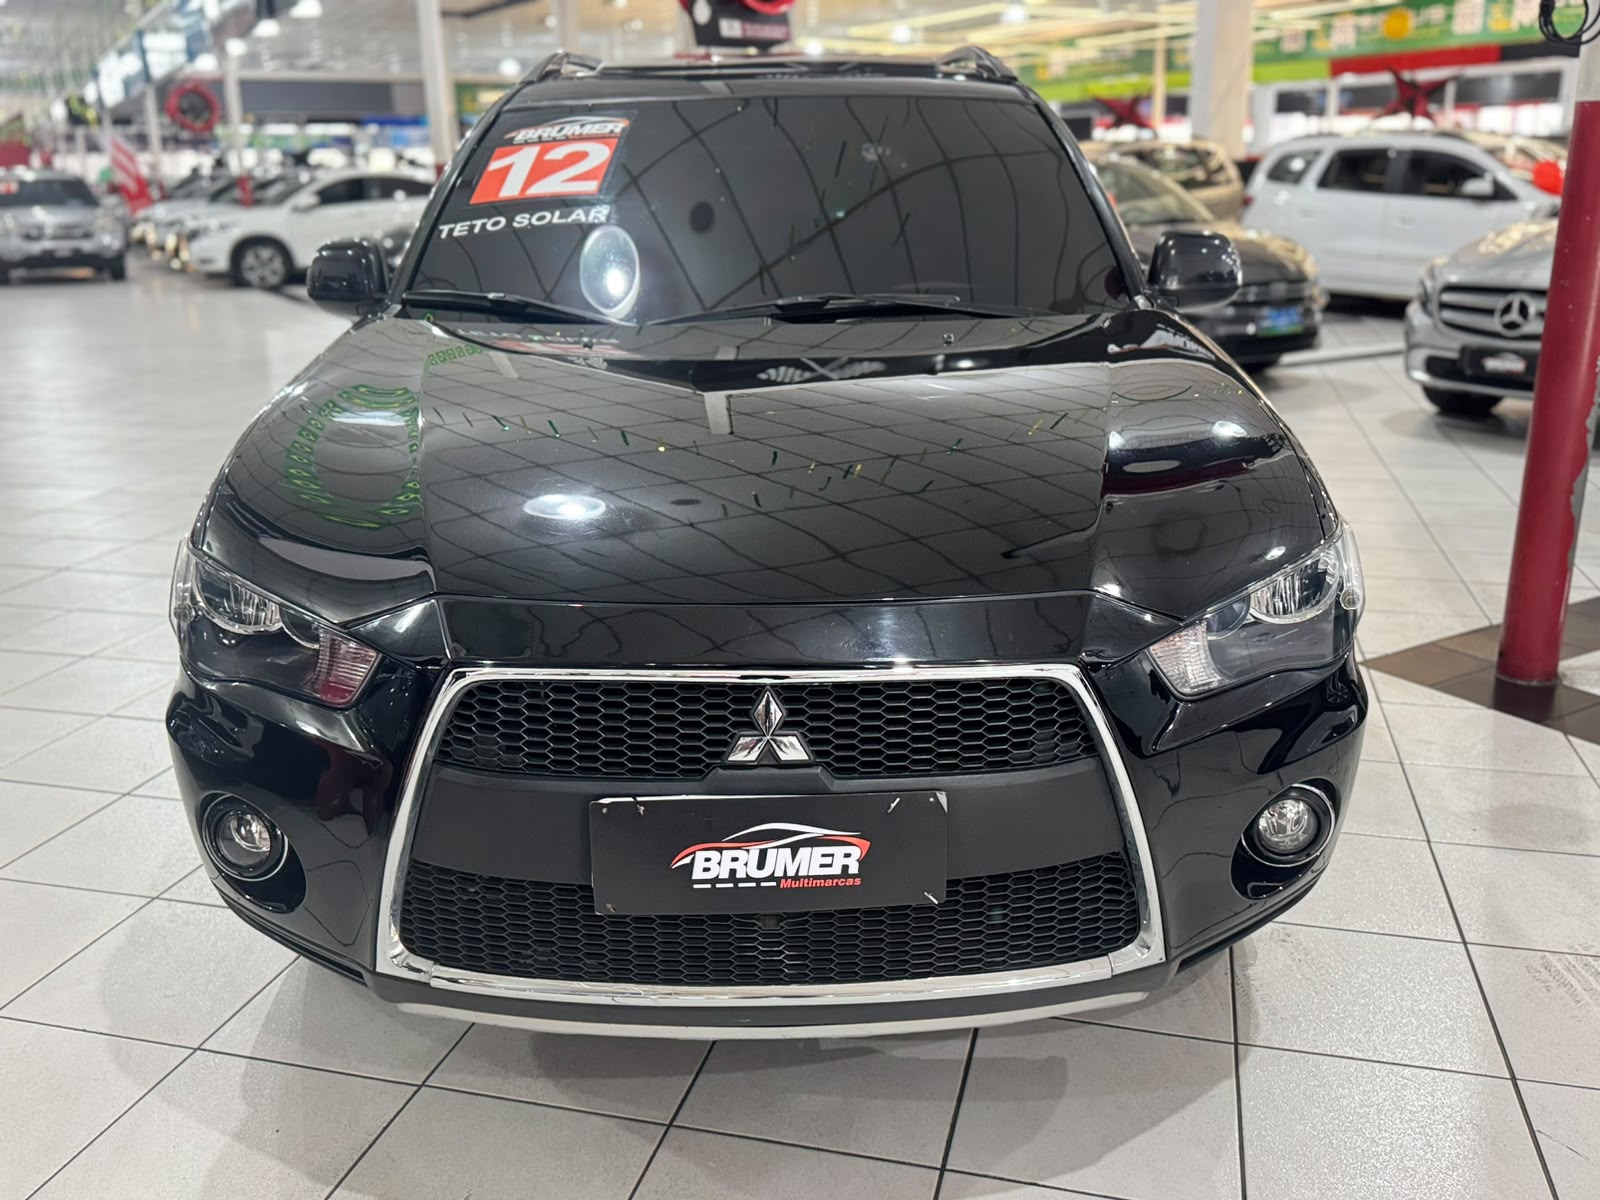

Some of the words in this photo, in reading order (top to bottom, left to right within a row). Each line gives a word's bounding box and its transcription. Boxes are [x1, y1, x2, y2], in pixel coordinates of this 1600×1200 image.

[513, 121, 624, 142] BRUMER
[488, 142, 611, 198] 12
[439, 216, 507, 239] TETO
[512, 205, 611, 228] SOLAR
[692, 846, 862, 880] BRUMER
[780, 877, 862, 889] Multimarcas
